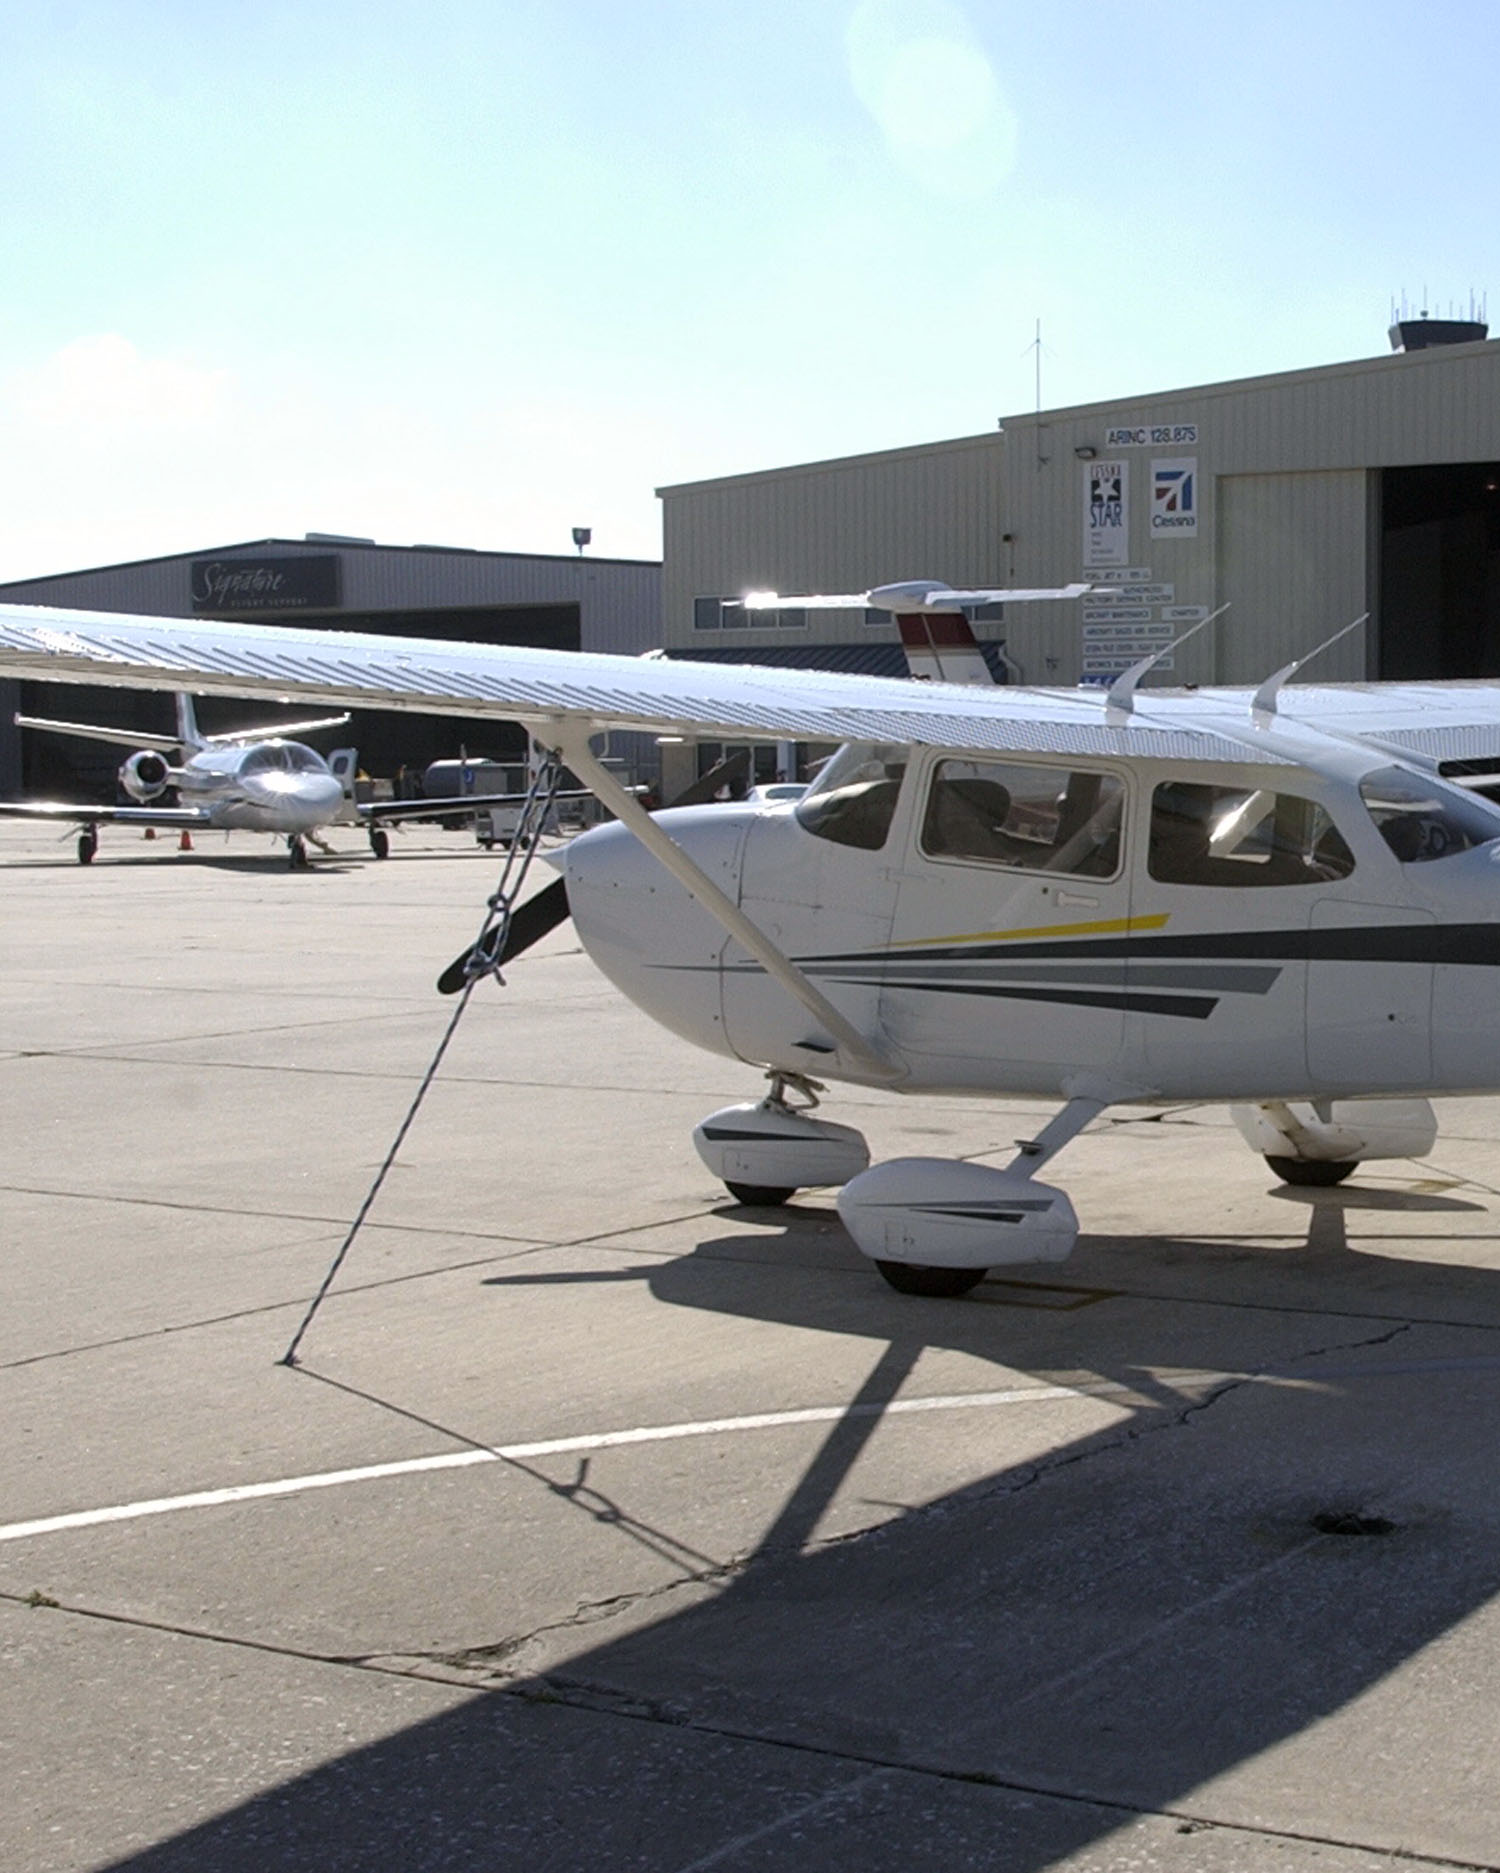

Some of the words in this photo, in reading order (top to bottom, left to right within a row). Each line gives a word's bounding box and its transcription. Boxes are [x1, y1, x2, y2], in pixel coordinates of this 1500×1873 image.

[1108, 429, 1146, 445] ARINC
[1090, 501, 1122, 529] STAR
[1152, 514, 1196, 528] Cessna
